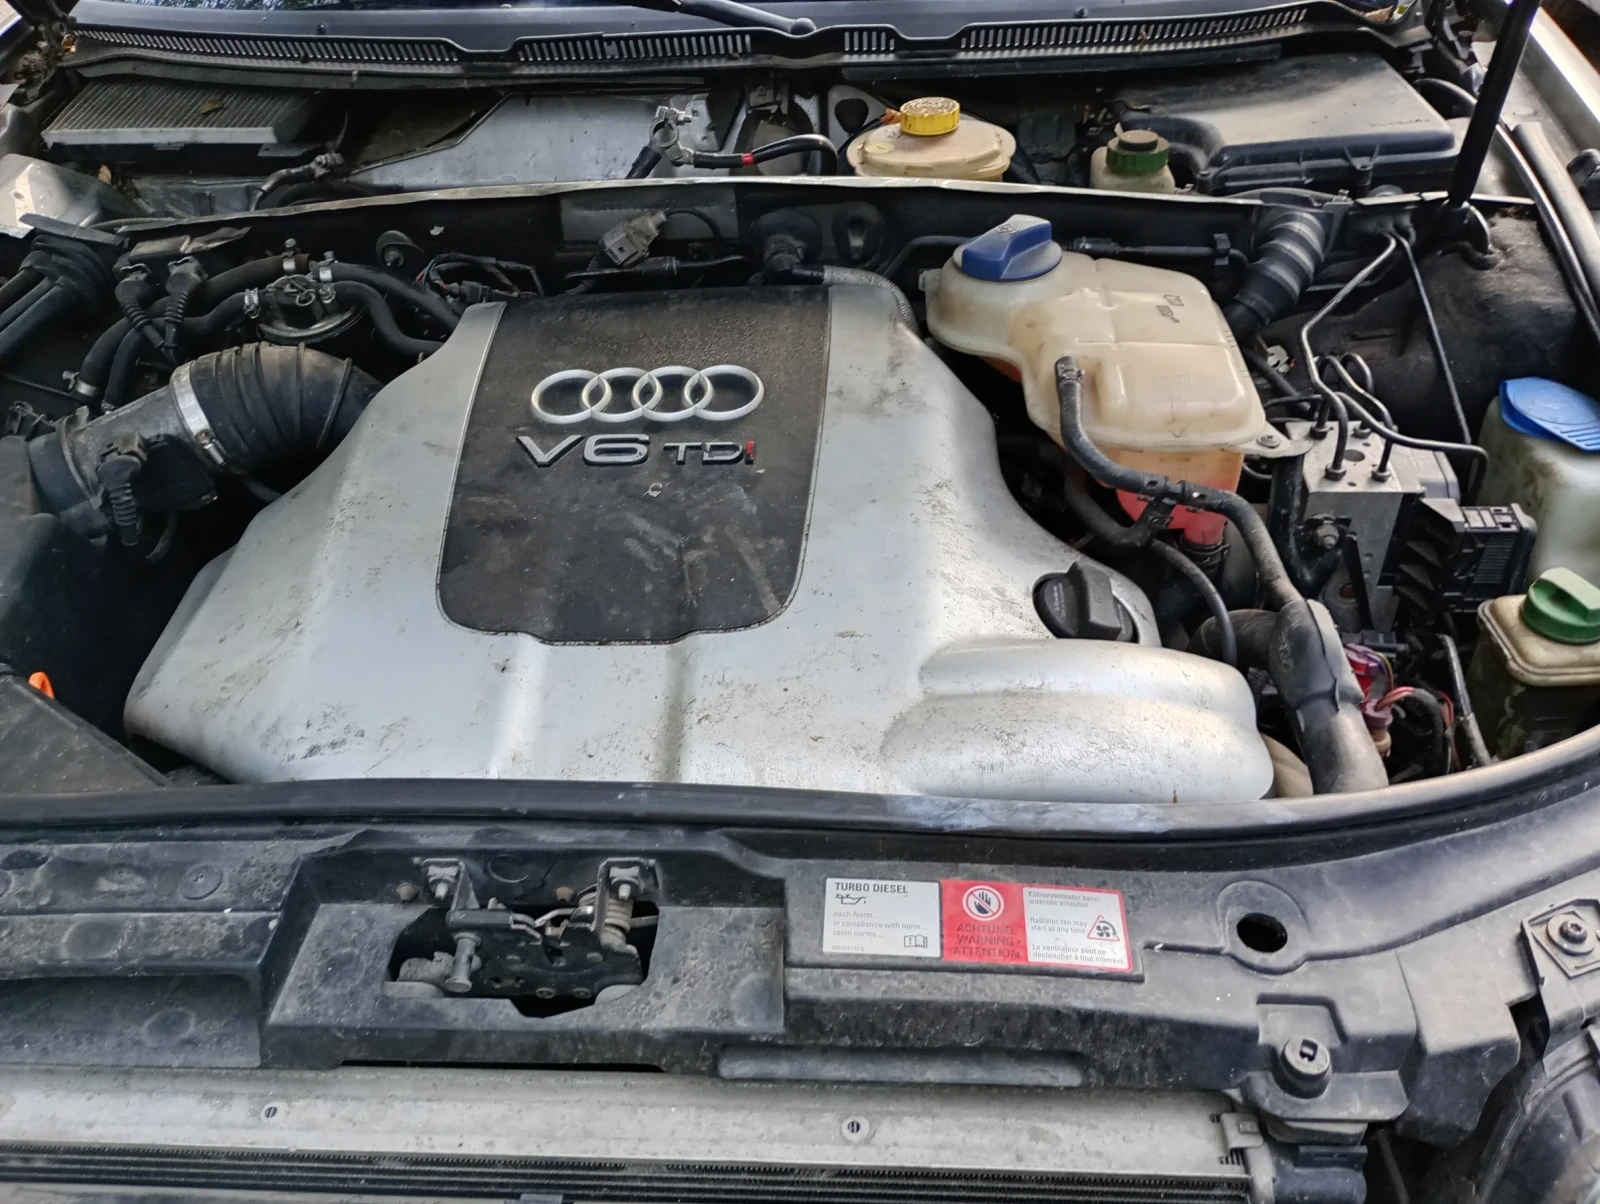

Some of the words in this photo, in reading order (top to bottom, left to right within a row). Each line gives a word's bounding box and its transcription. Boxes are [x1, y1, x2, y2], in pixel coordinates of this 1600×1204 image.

[516, 433, 650, 468] V6
[663, 440, 755, 465] TDI
[835, 882, 870, 892] TURBO
[873, 884, 908, 894] DIESEL
[841, 920, 882, 928] compliance
[957, 924, 1013, 935] ACHTUNG
[957, 934, 1014, 946] WARNING
[953, 947, 1020, 958] ATTENTION
[1042, 944, 1079, 953] ventilateur
[1033, 951, 1072, 960] déclencher
